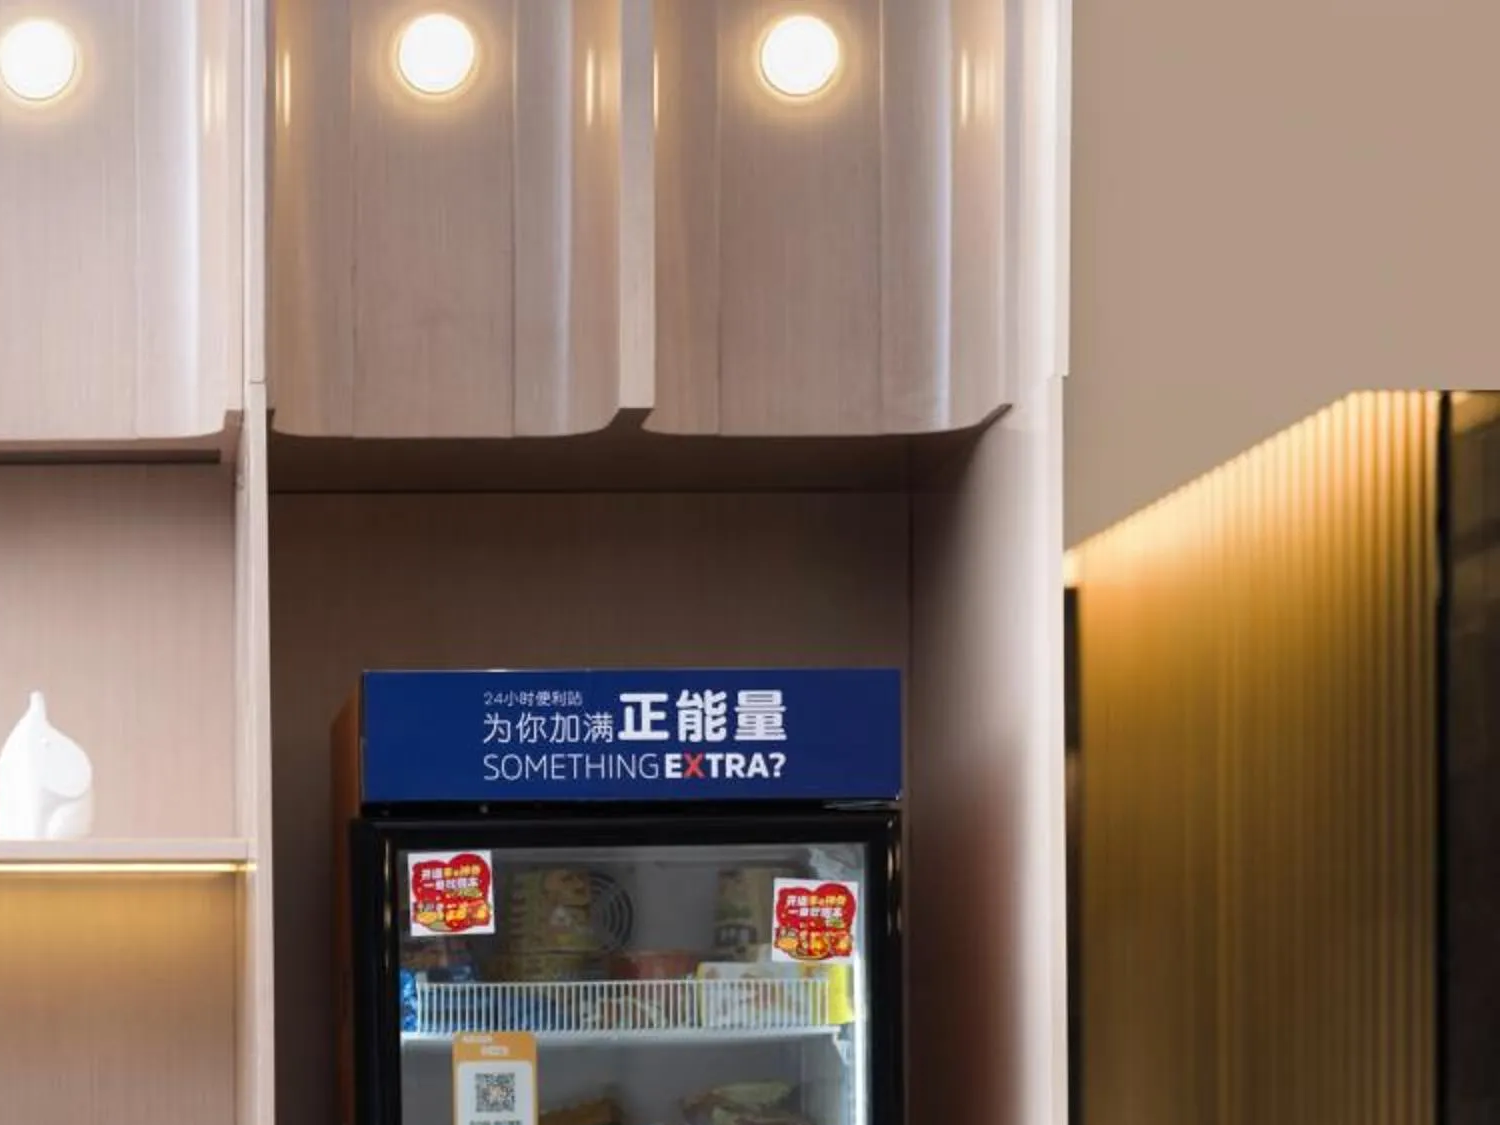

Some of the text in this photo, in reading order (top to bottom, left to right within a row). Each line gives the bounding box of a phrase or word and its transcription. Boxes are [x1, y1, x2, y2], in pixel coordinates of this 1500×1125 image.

[483, 689, 787, 743] 为你加满正能量
[483, 752, 787, 780] SOMETHING EXTRA?
